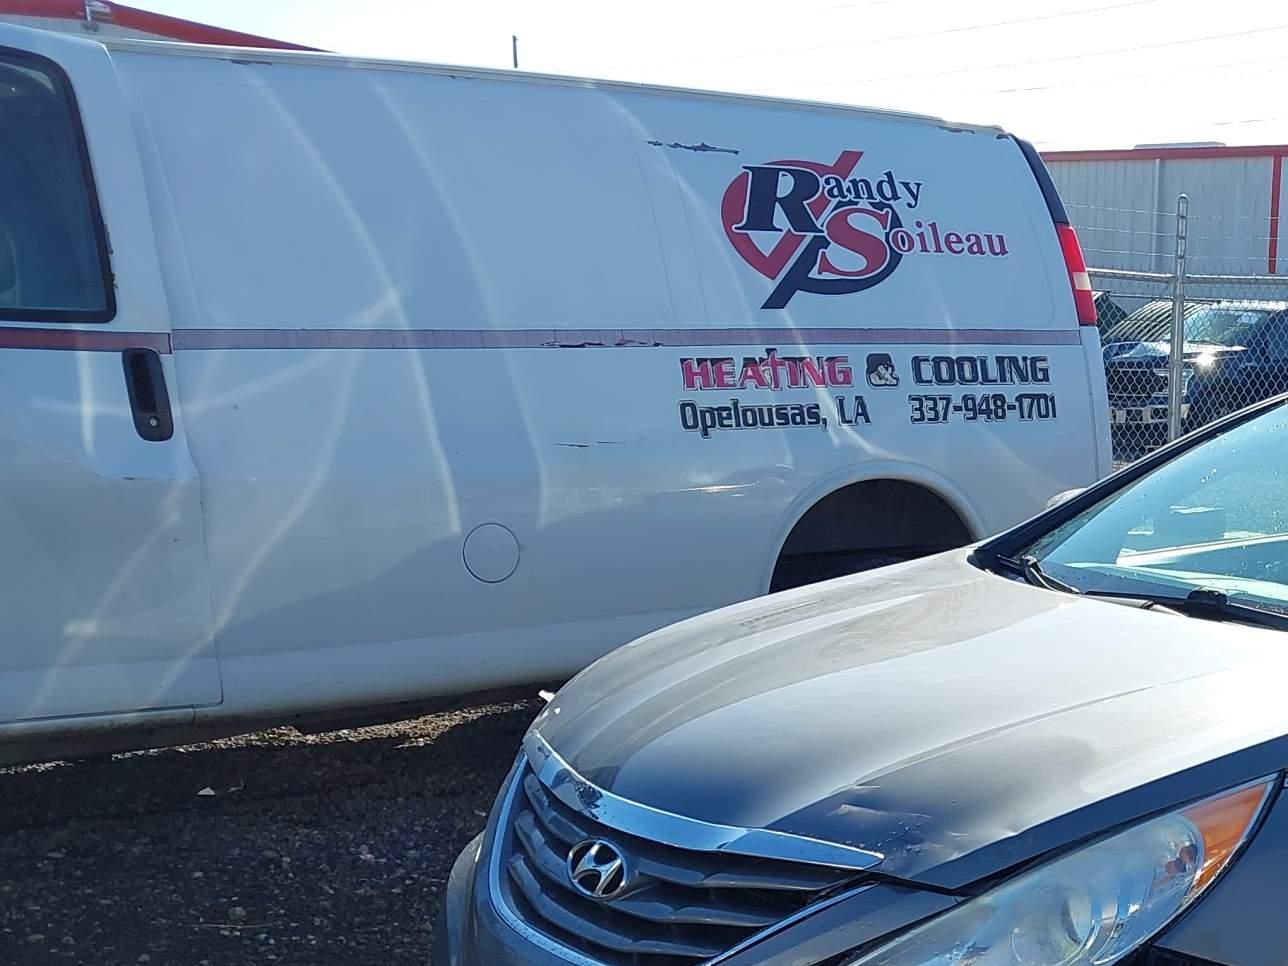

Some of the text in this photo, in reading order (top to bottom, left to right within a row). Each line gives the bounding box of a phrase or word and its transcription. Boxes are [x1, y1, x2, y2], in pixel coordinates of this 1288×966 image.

[735, 164, 921, 233] Randy
[817, 207, 1009, 276] Soileau
[911, 355, 1050, 386] COOLING
[679, 396, 872, 437] Opelousas, LA
[910, 393, 1057, 424] 337-948-1701
